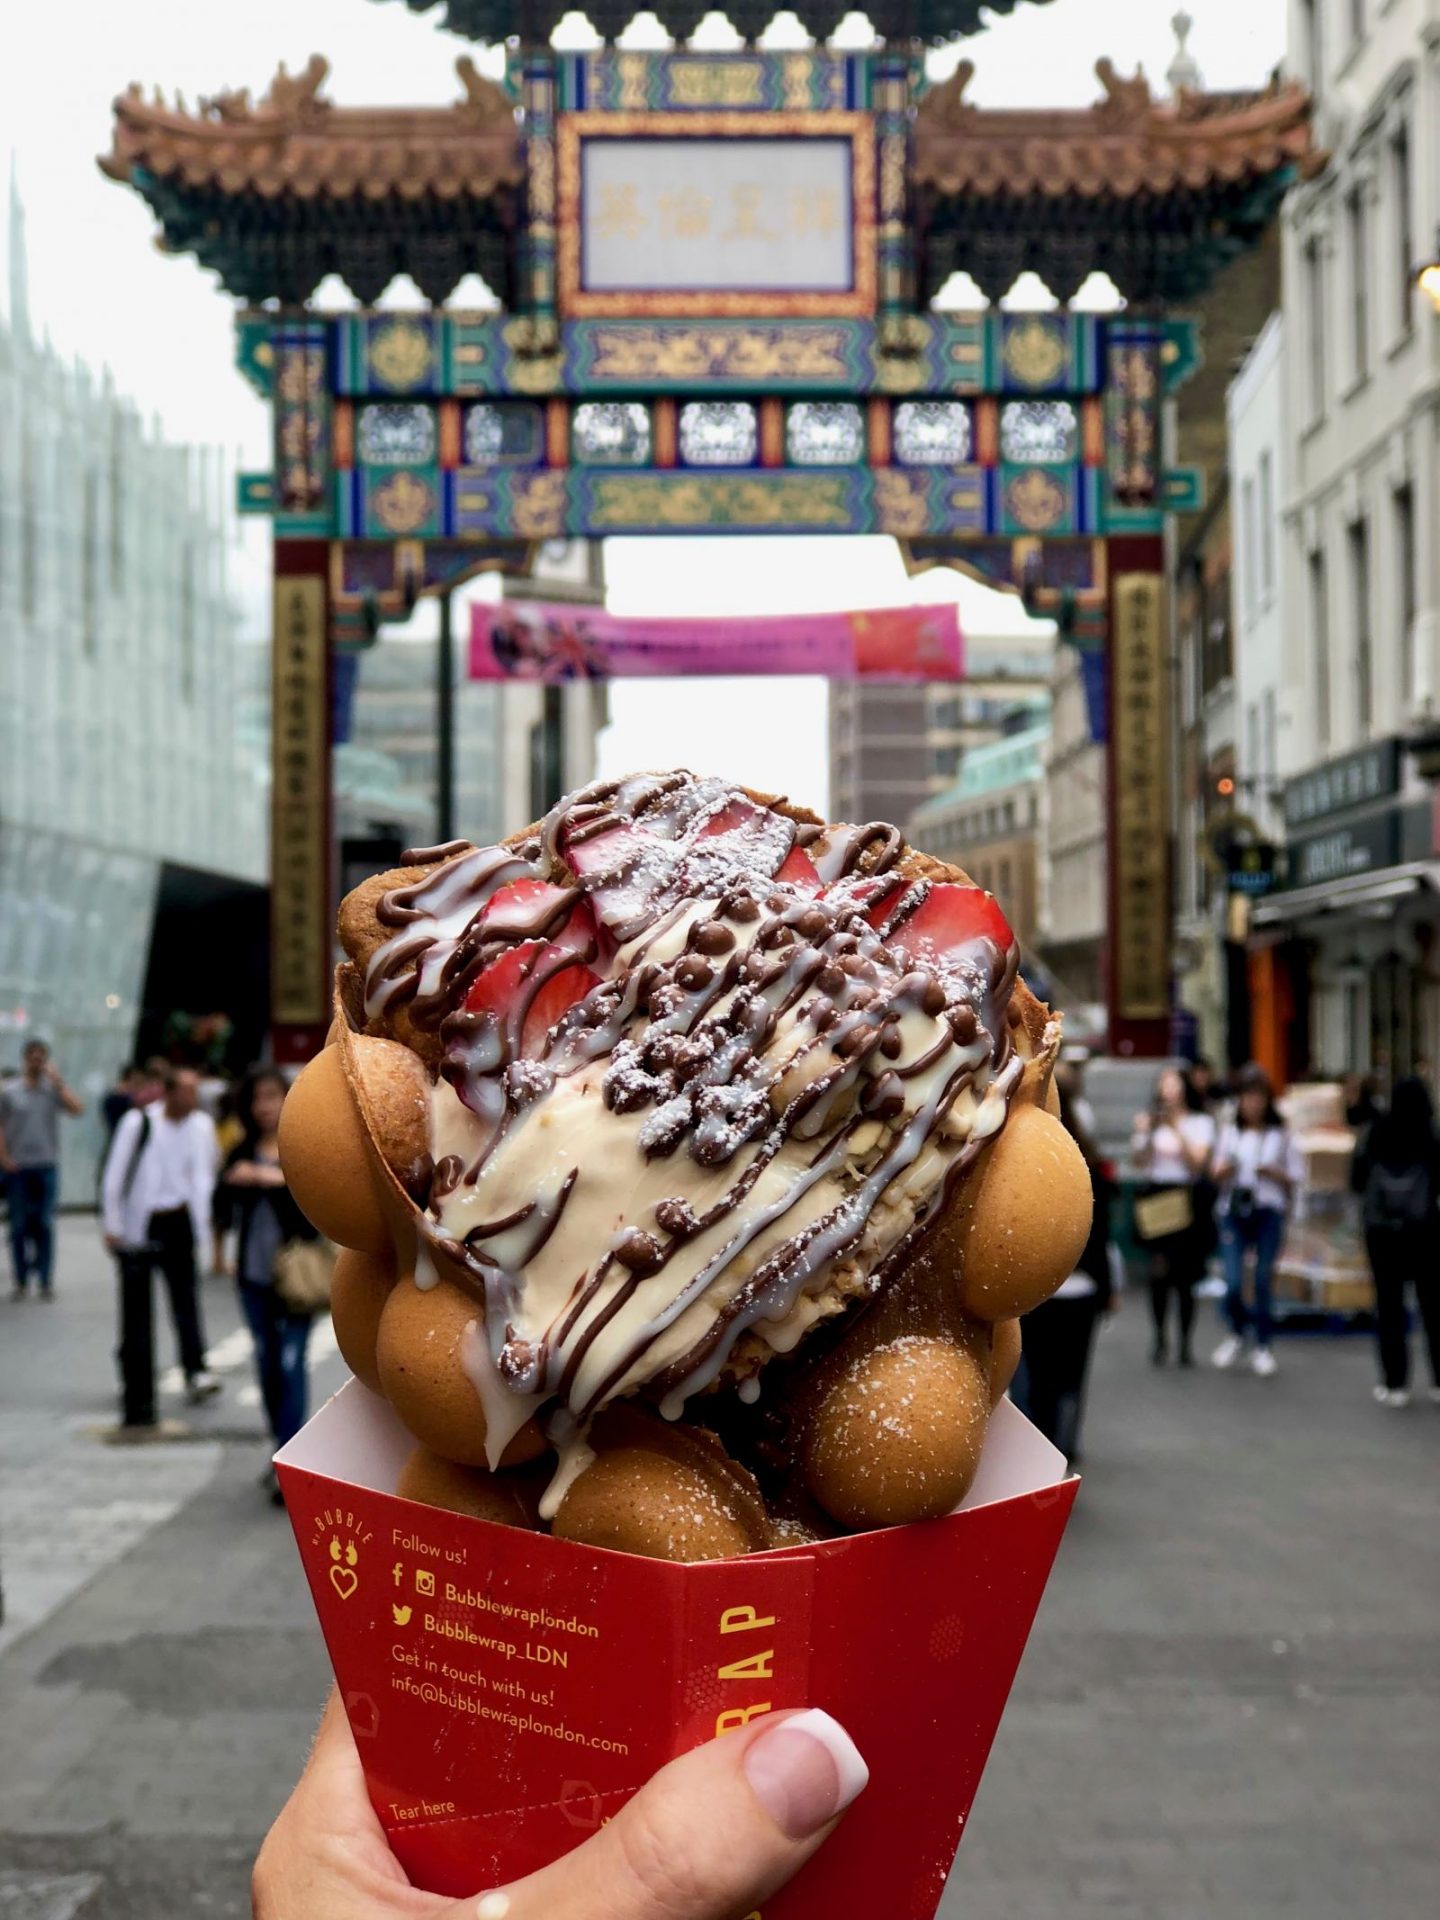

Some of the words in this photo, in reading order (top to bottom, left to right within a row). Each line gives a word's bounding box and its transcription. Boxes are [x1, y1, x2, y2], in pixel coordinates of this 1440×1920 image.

[314, 1508, 373, 1544] BUBBLE
[392, 1528, 441, 1557] Follow
[445, 1548, 467, 1565] us!
[445, 1583, 599, 1638] Bubblewraplondon
[424, 1613, 568, 1668] Bubblewrap_LDN
[391, 1644, 420, 1667] Get
[424, 1658, 438, 1673] in
[441, 1663, 487, 1688] touch
[491, 1678, 526, 1699] with
[530, 1690, 555, 1707] us!
[715, 1605, 776, 1738] RAP
[391, 1672, 629, 1755] info@bubblewraplondon.com
[389, 1803, 419, 1821] Tear
[422, 1800, 456, 1817] here
